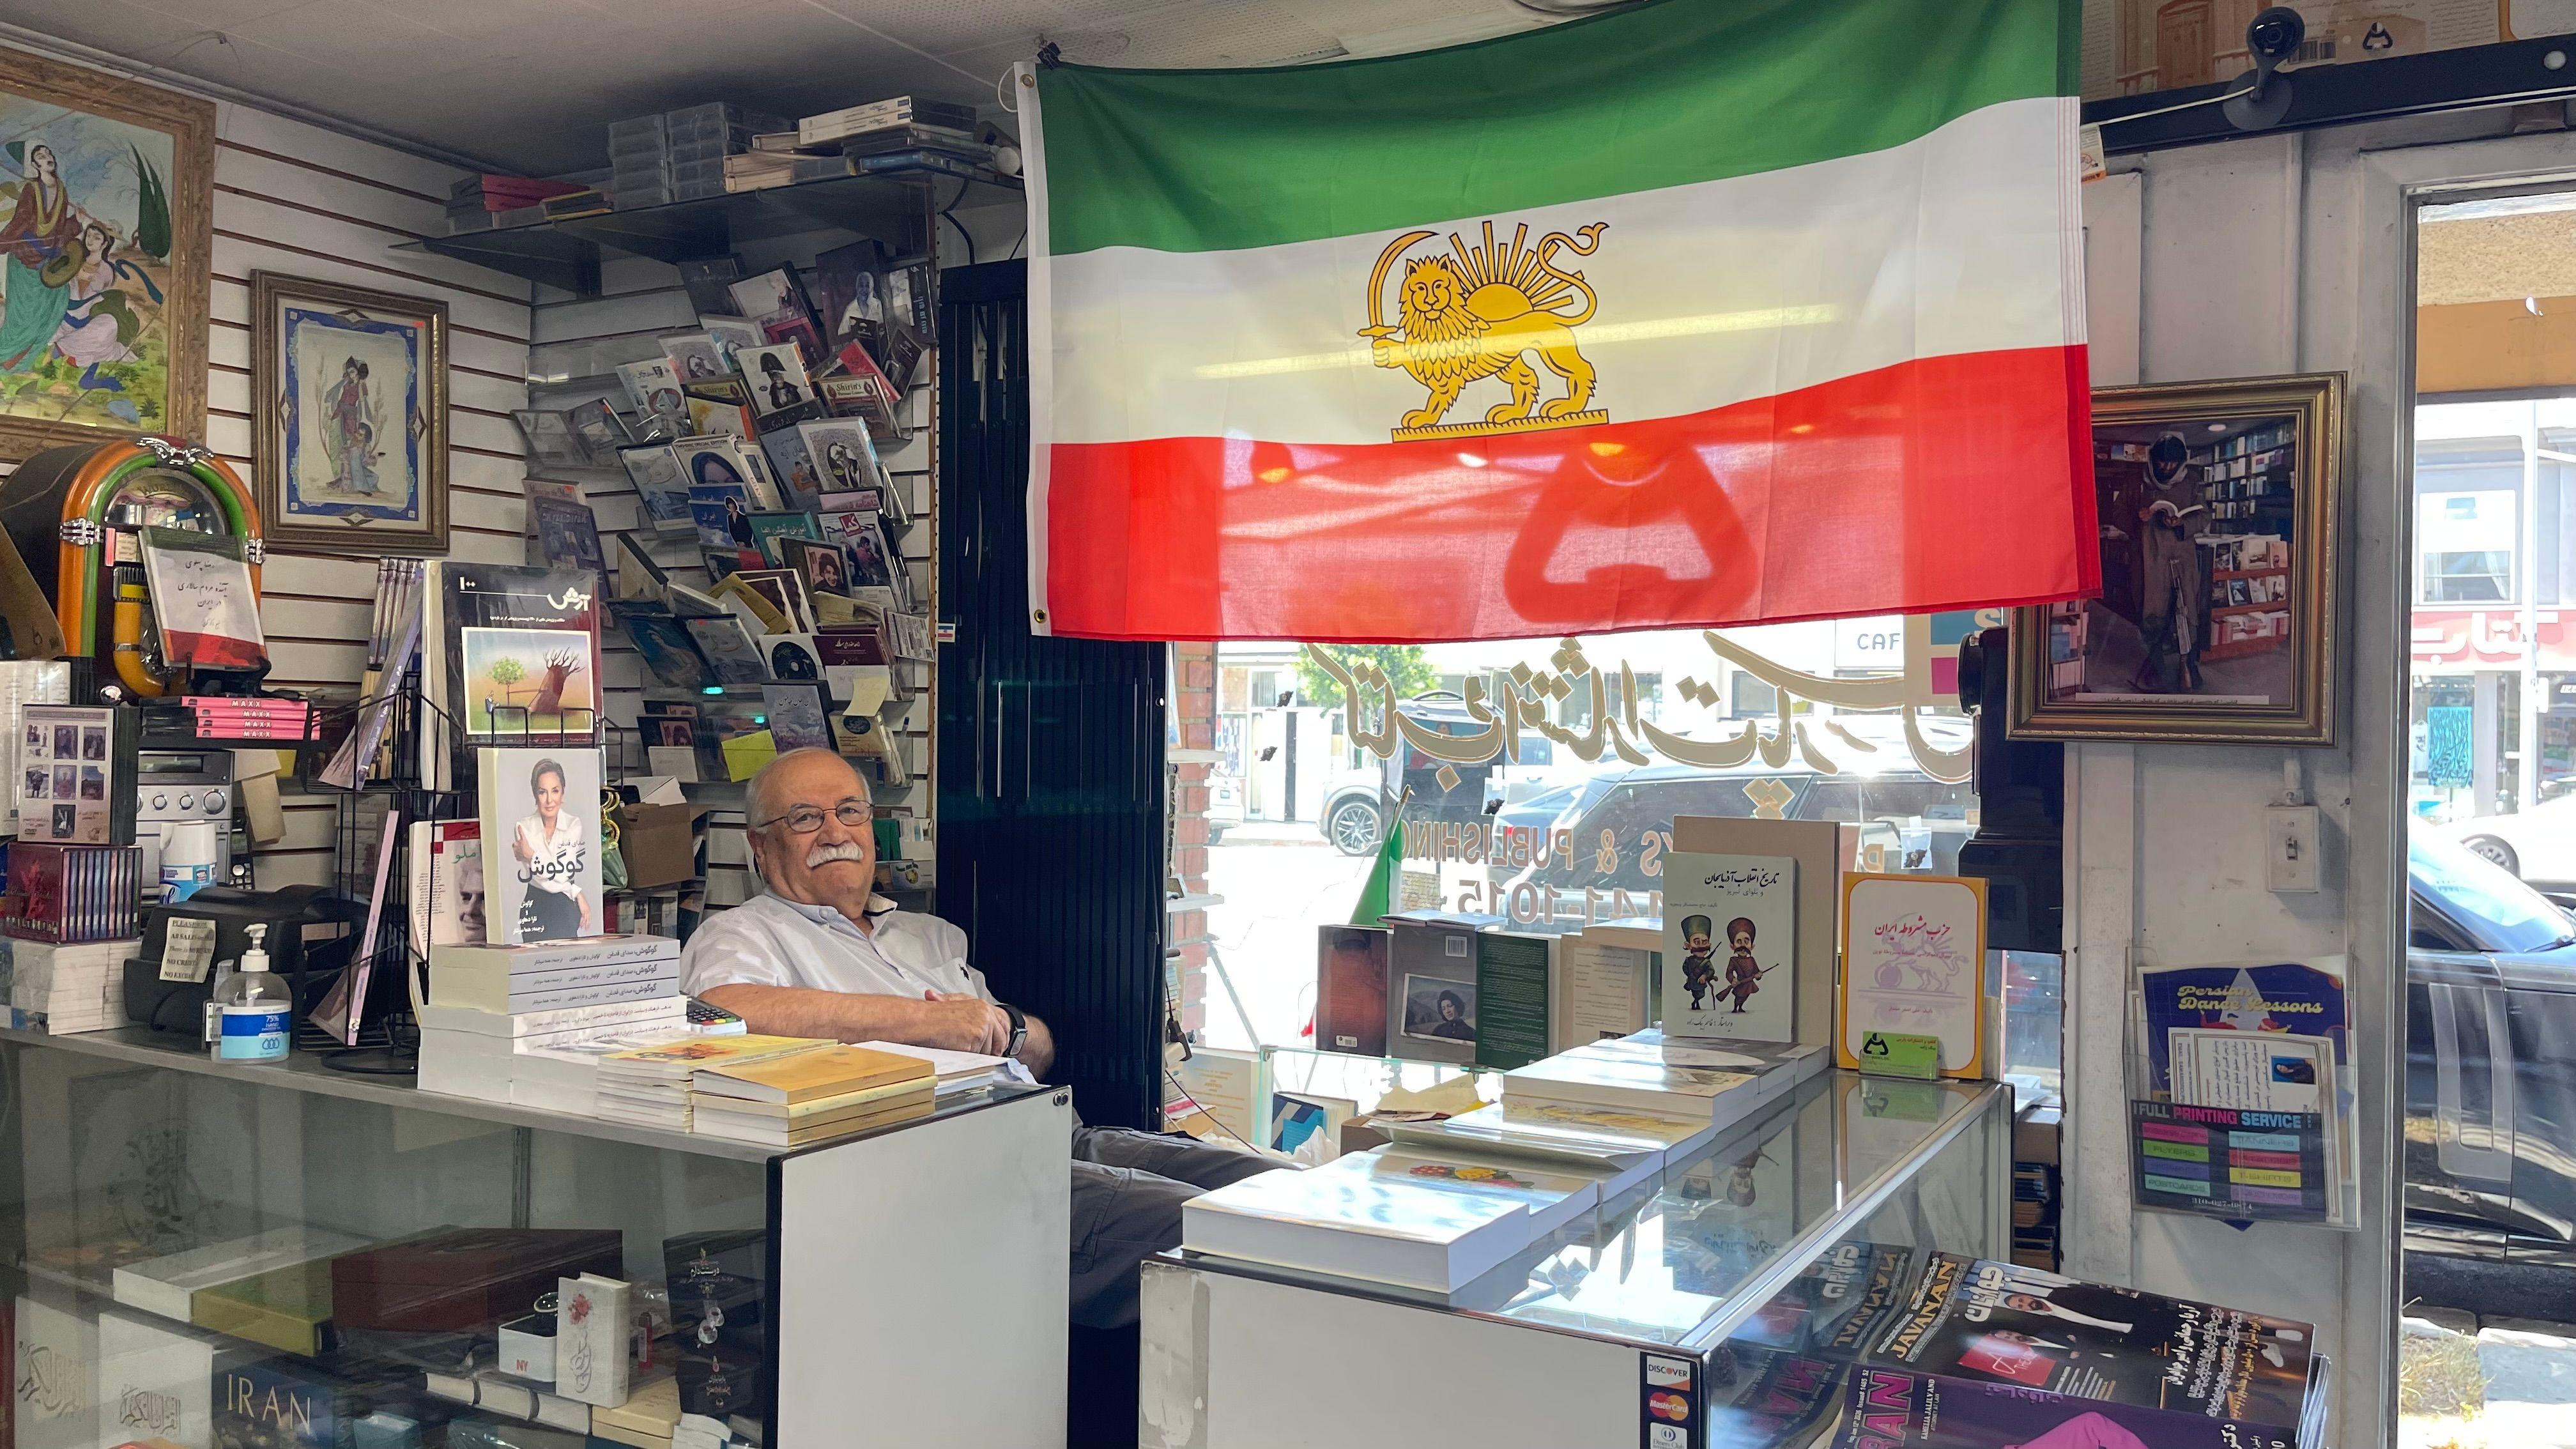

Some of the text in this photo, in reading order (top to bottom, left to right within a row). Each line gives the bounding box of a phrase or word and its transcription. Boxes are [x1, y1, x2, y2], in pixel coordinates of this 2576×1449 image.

[836, 383, 862, 392] Shirin's
[197, 599, 214, 610] ایران
[1857, 632, 1901, 651] CAF
[231, 700, 261, 708] MAXX
[518, 847, 586, 885] گوگوش
[1705, 868, 1781, 889] تاریخ انقلاب آذربایجان
[1874, 914, 1951, 941] حزب مشروطه ایران
[2177, 985, 2254, 997] Persian
[2177, 997, 2324, 1014] Dance Lessons
[2140, 1104, 2301, 1128] FULL PRINTING SERVICE
[2152, 1144, 2196, 1158] FLYERS
[2147, 1177, 2207, 1193] POSTCARDS
[2239, 1172, 2292, 1183] T-SHIRTS
[1963, 1265, 2012, 1322] جوانان
[1889, 1260, 1959, 1360] JAVANAN
[516, 1359, 529, 1372] NY
[1648, 1363, 1689, 1379] DISCOVER
[1923, 1378, 1936, 1411] JALILVAND
[227, 1374, 311, 1436] IRAN
[1650, 1399, 1689, 1414] MasterCard
[1653, 1438, 1685, 1449] Diners Club
